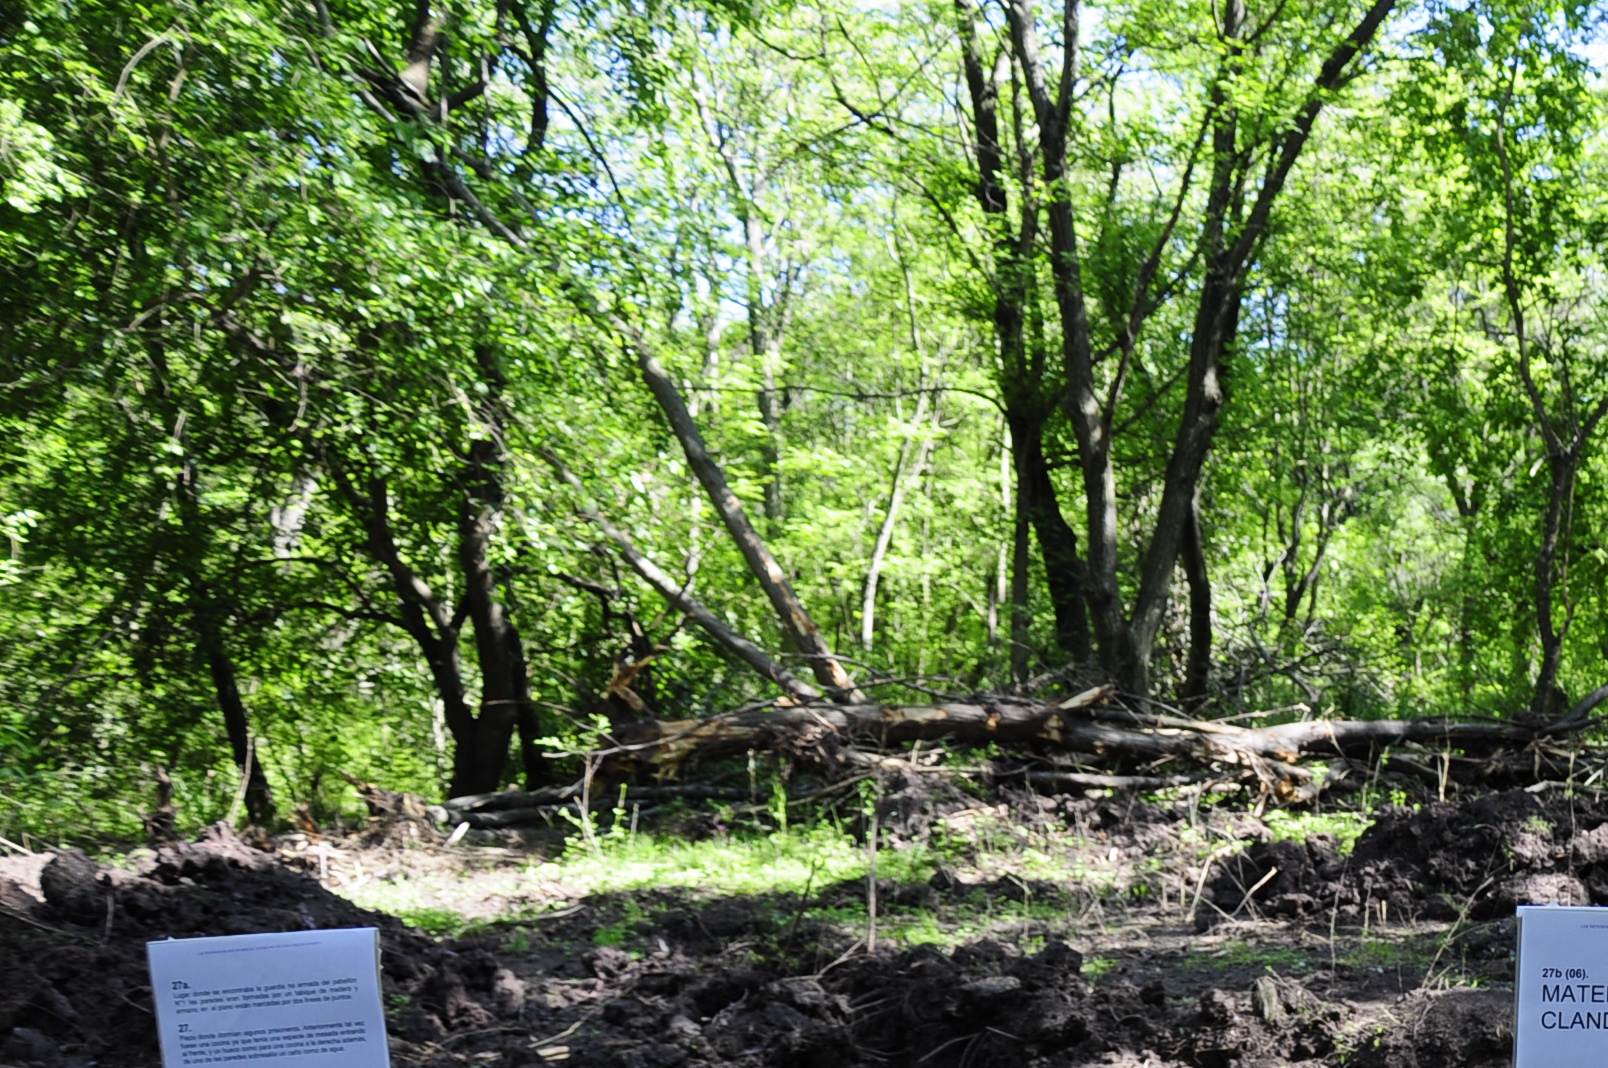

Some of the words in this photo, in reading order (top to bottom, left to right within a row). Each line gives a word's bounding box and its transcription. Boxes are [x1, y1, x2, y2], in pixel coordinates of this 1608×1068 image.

[1542, 968, 1562, 979] 27b
[1565, 969, 1589, 980] (06).
[178, 1024, 192, 1033] 27.
